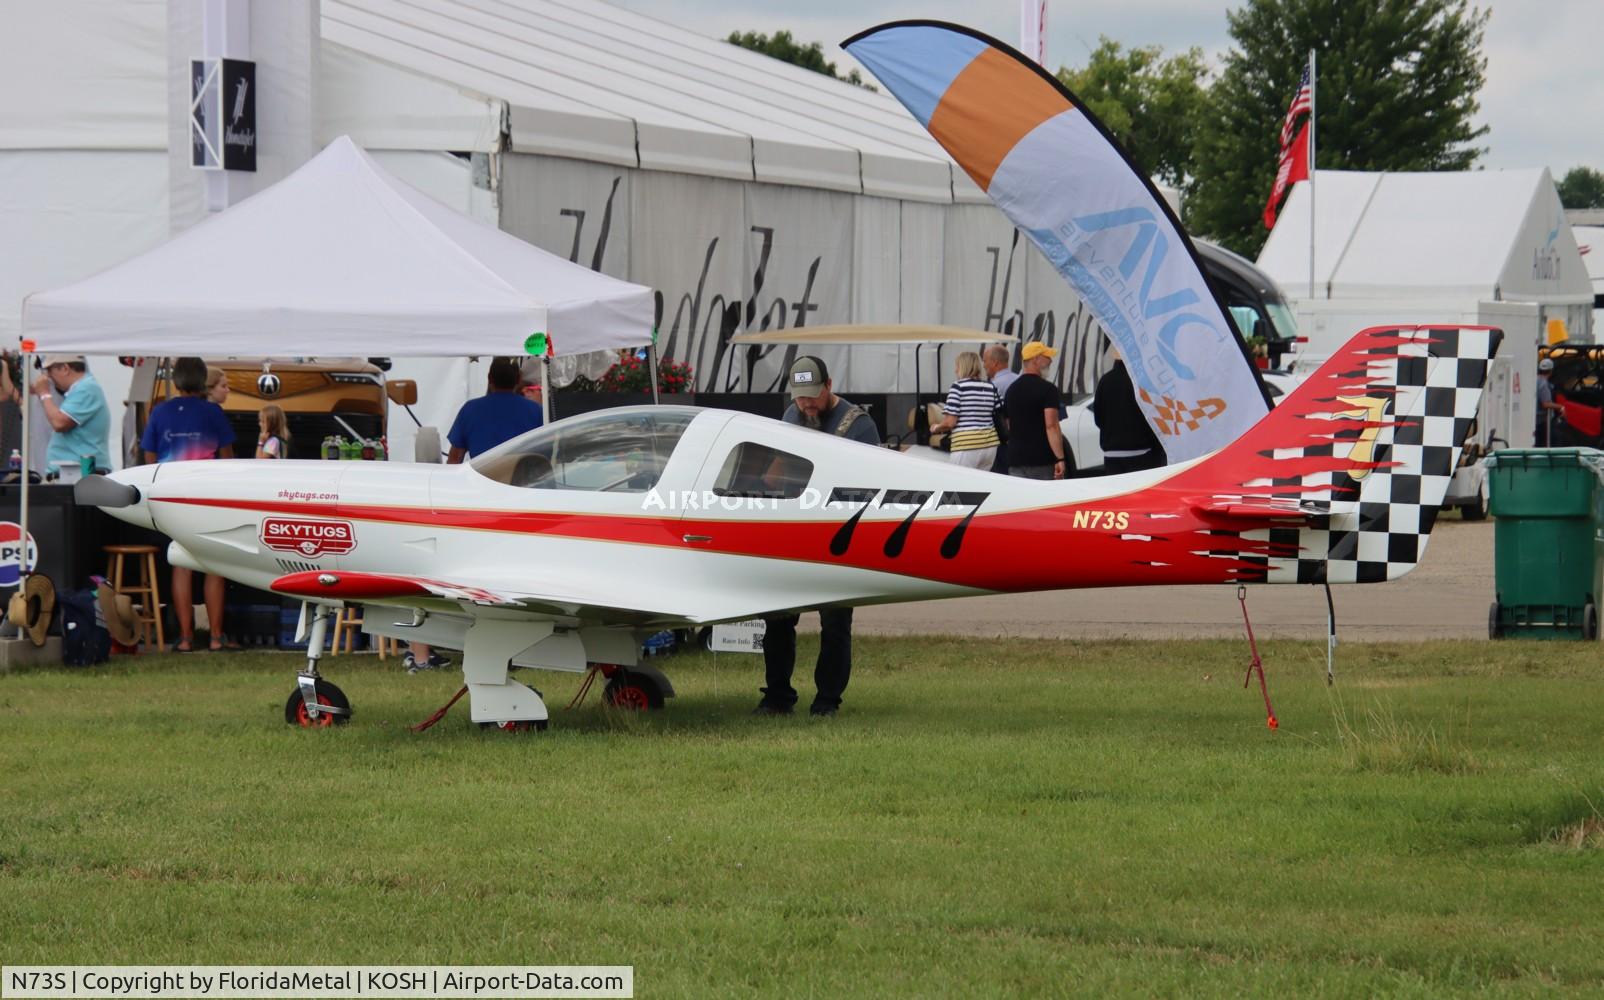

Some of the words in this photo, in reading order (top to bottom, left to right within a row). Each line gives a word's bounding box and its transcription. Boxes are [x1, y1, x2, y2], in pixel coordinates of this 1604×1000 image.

[278, 489, 339, 501] skytugs.com
[825, 487, 992, 559] 777
[1073, 511, 1130, 530] N73S
[269, 523, 347, 538] SKYTUGS
